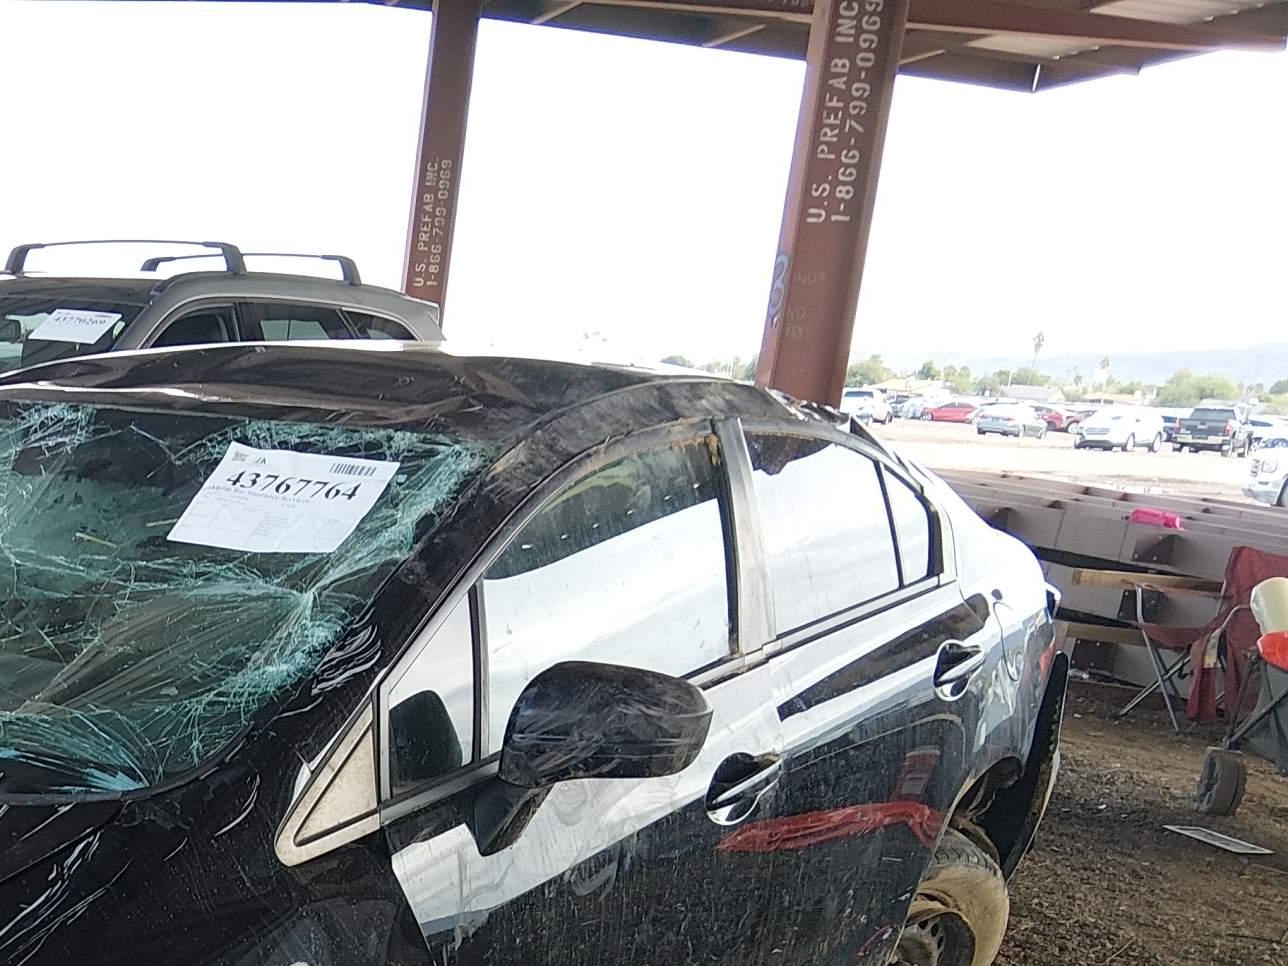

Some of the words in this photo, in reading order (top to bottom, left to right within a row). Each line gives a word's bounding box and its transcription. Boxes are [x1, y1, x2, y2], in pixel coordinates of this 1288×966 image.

[817, 57, 850, 160] PREFAB
[830, 0, 884, 223] 1-866-799-0969
[417, 193, 434, 251] PREFAB
[426, 159, 452, 286] 1-866-799-0969
[806, 176, 831, 223] U.S.
[413, 258, 427, 287] U.S.
[226, 469, 362, 501] 43767764
